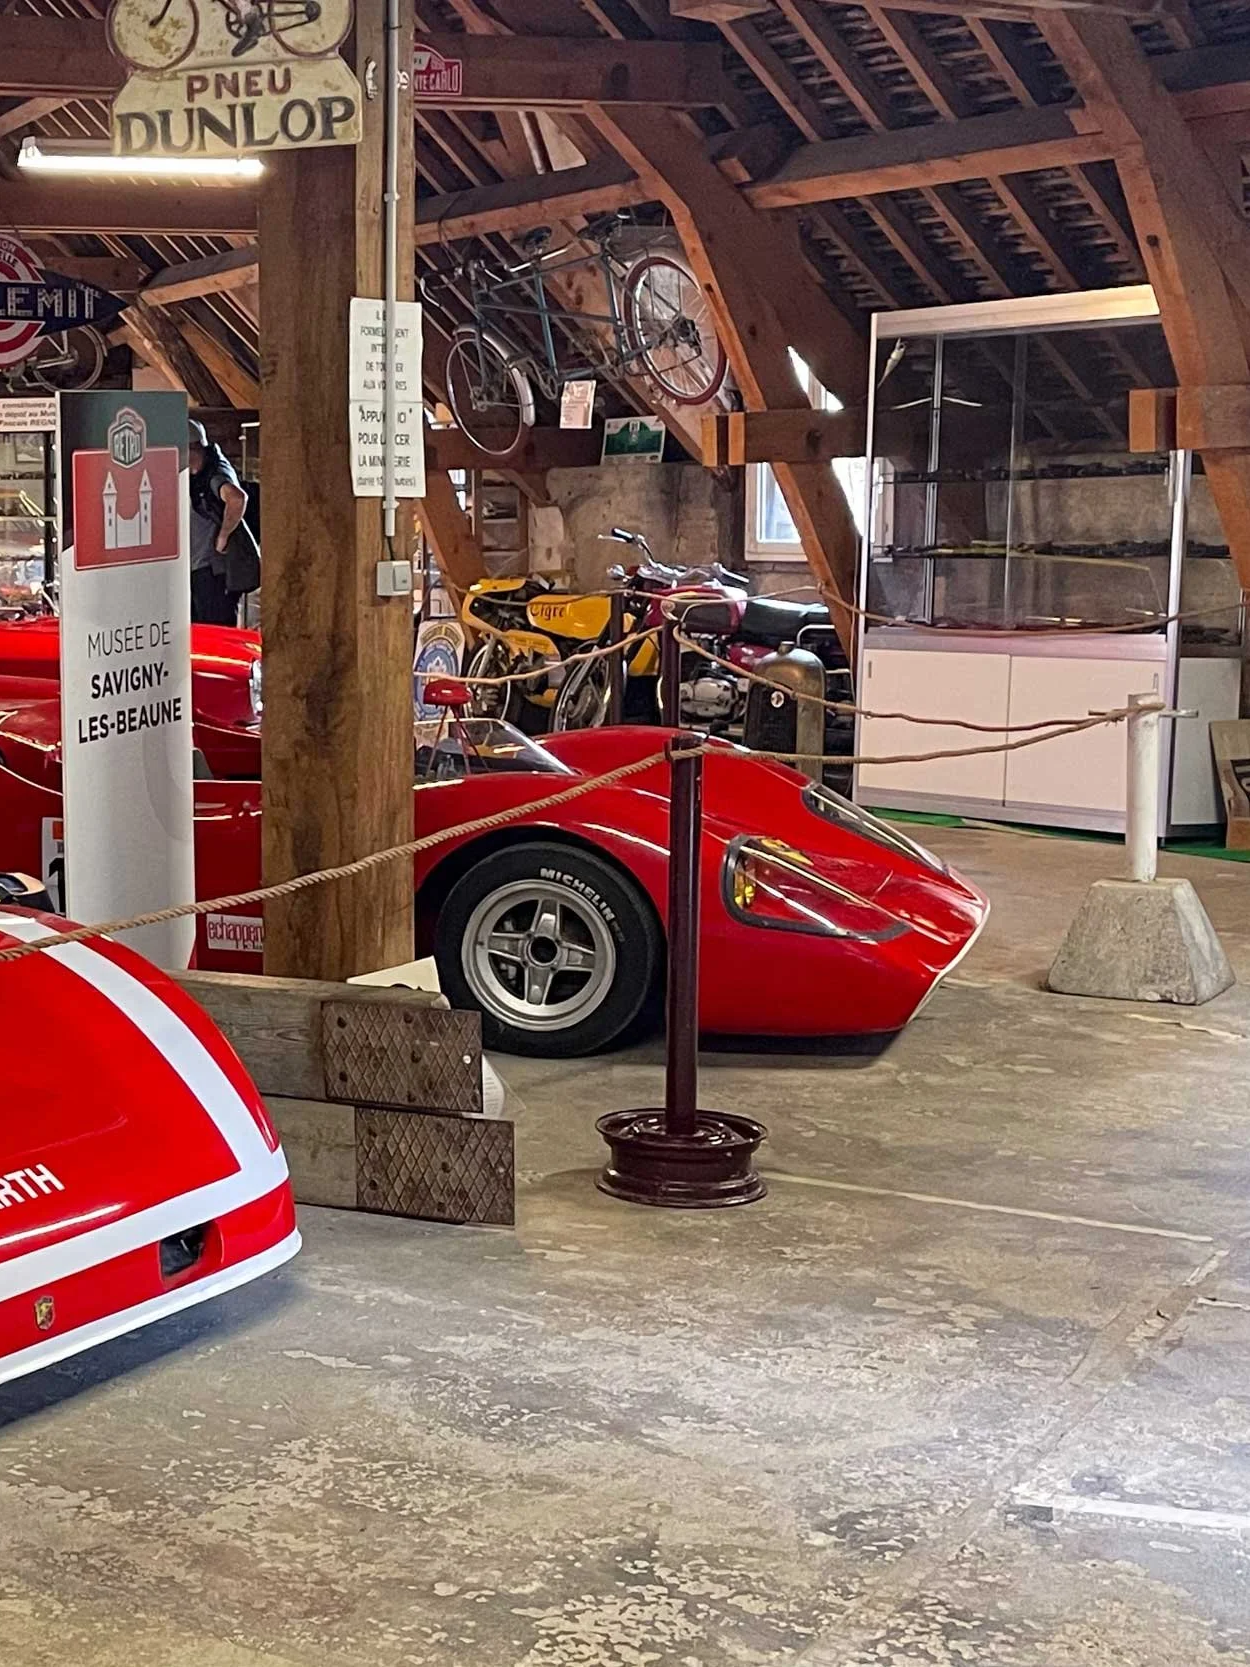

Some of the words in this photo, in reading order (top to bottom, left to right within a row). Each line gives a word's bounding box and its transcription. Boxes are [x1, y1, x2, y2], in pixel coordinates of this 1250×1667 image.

[186, 66, 292, 103] PNEU
[116, 96, 356, 154] DUNLOP
[358, 432, 379, 445] POUR
[358, 455, 367, 467] LA
[88, 620, 144, 658] MUSÉE
[150, 620, 171, 649] DE
[91, 661, 169, 700] SAVIGNY-
[78, 697, 182, 744] LES-BEAUNE
[539, 867, 616, 921] MICHELIN
